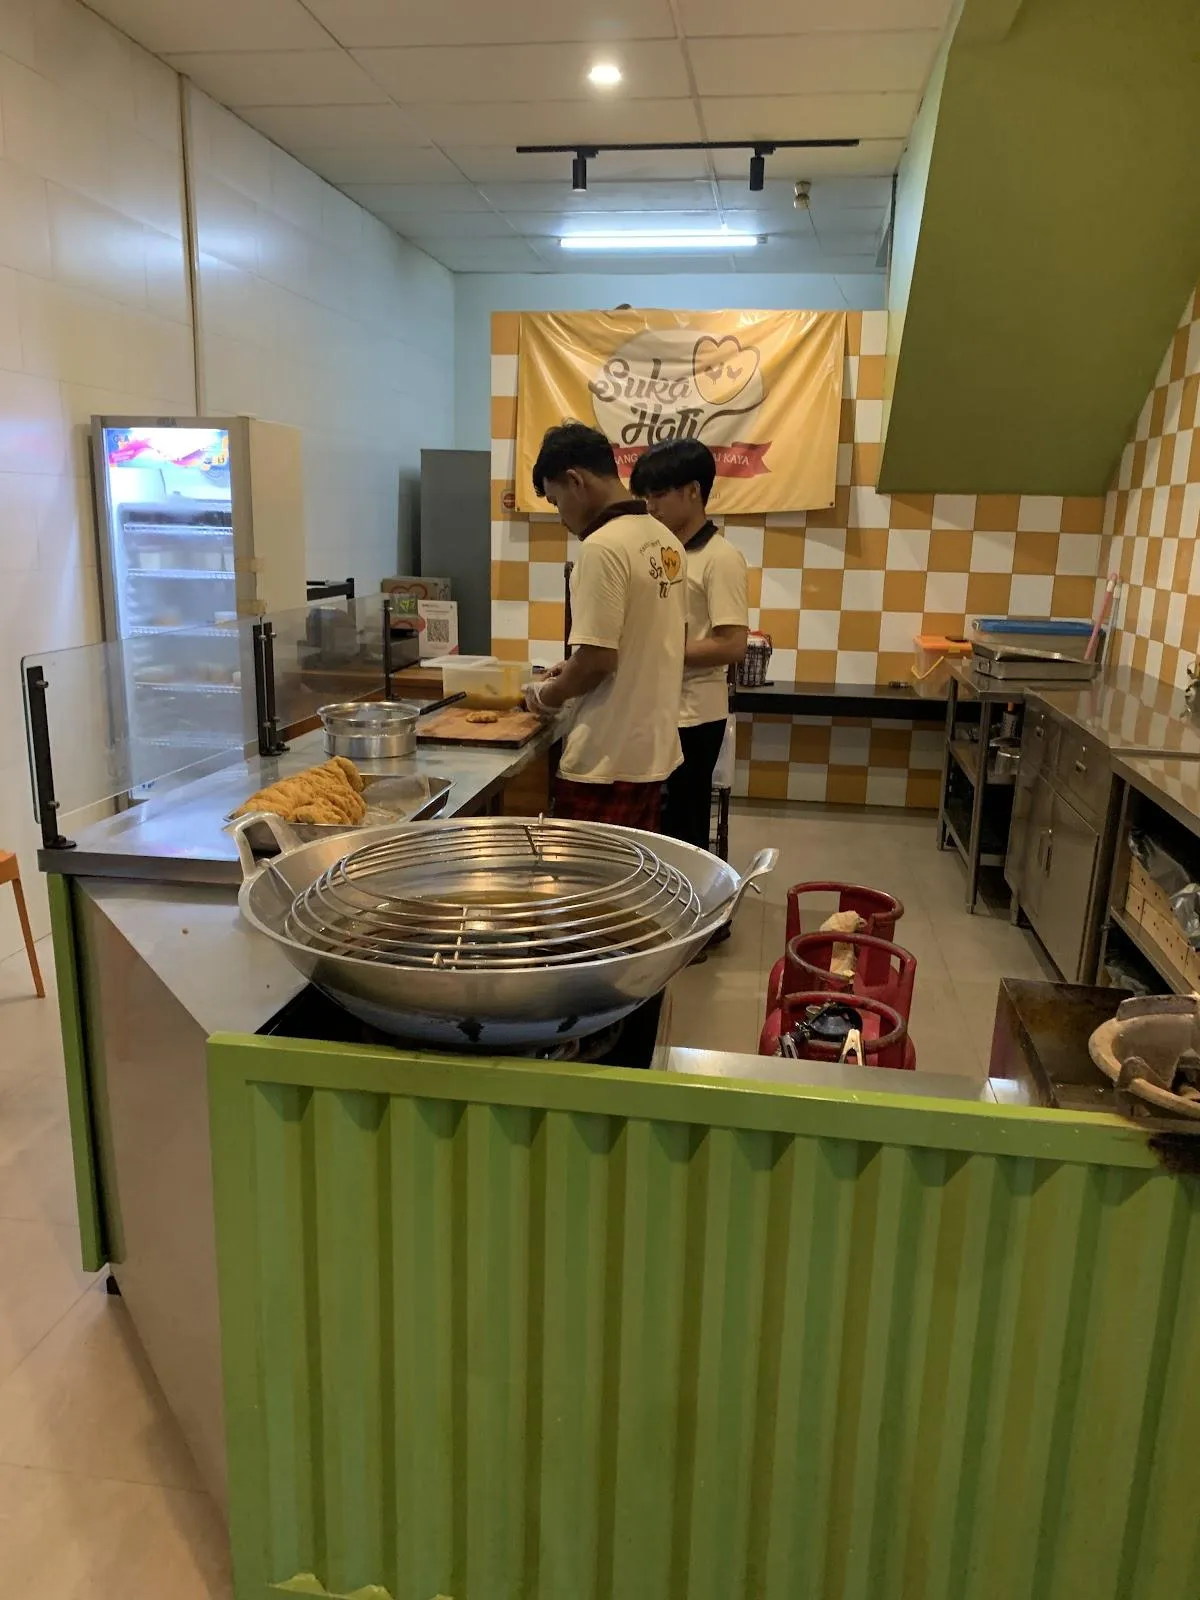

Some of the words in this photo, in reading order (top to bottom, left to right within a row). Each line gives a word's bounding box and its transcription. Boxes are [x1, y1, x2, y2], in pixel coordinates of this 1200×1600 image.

[588, 358, 693, 405] Suka
[621, 402, 704, 445] Hati
[723, 453, 749, 465] KAYA
